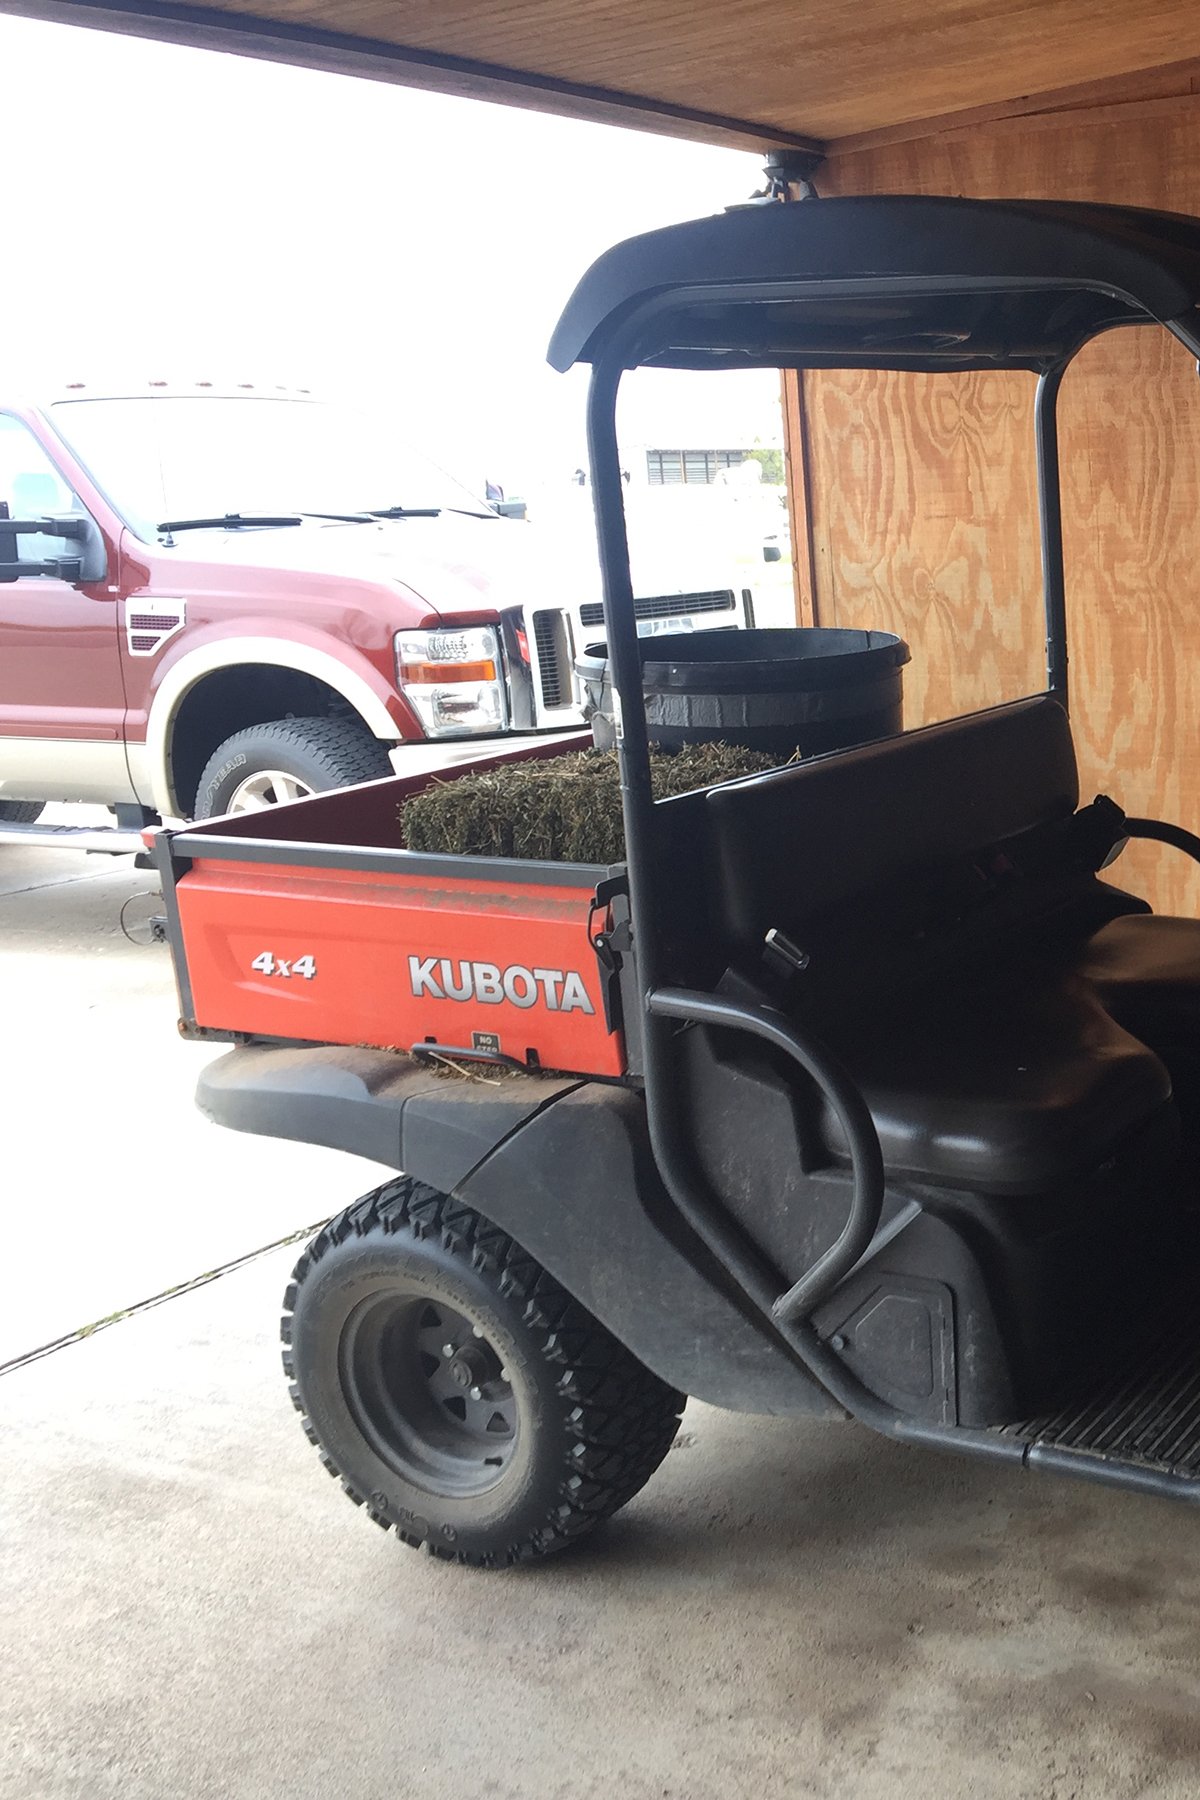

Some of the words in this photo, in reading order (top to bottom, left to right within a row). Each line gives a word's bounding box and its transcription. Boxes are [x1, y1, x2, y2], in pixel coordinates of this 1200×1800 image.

[251, 951, 317, 980] 4x4
[407, 955, 596, 1014] KUBOTA
[479, 1035, 492, 1045] NO
